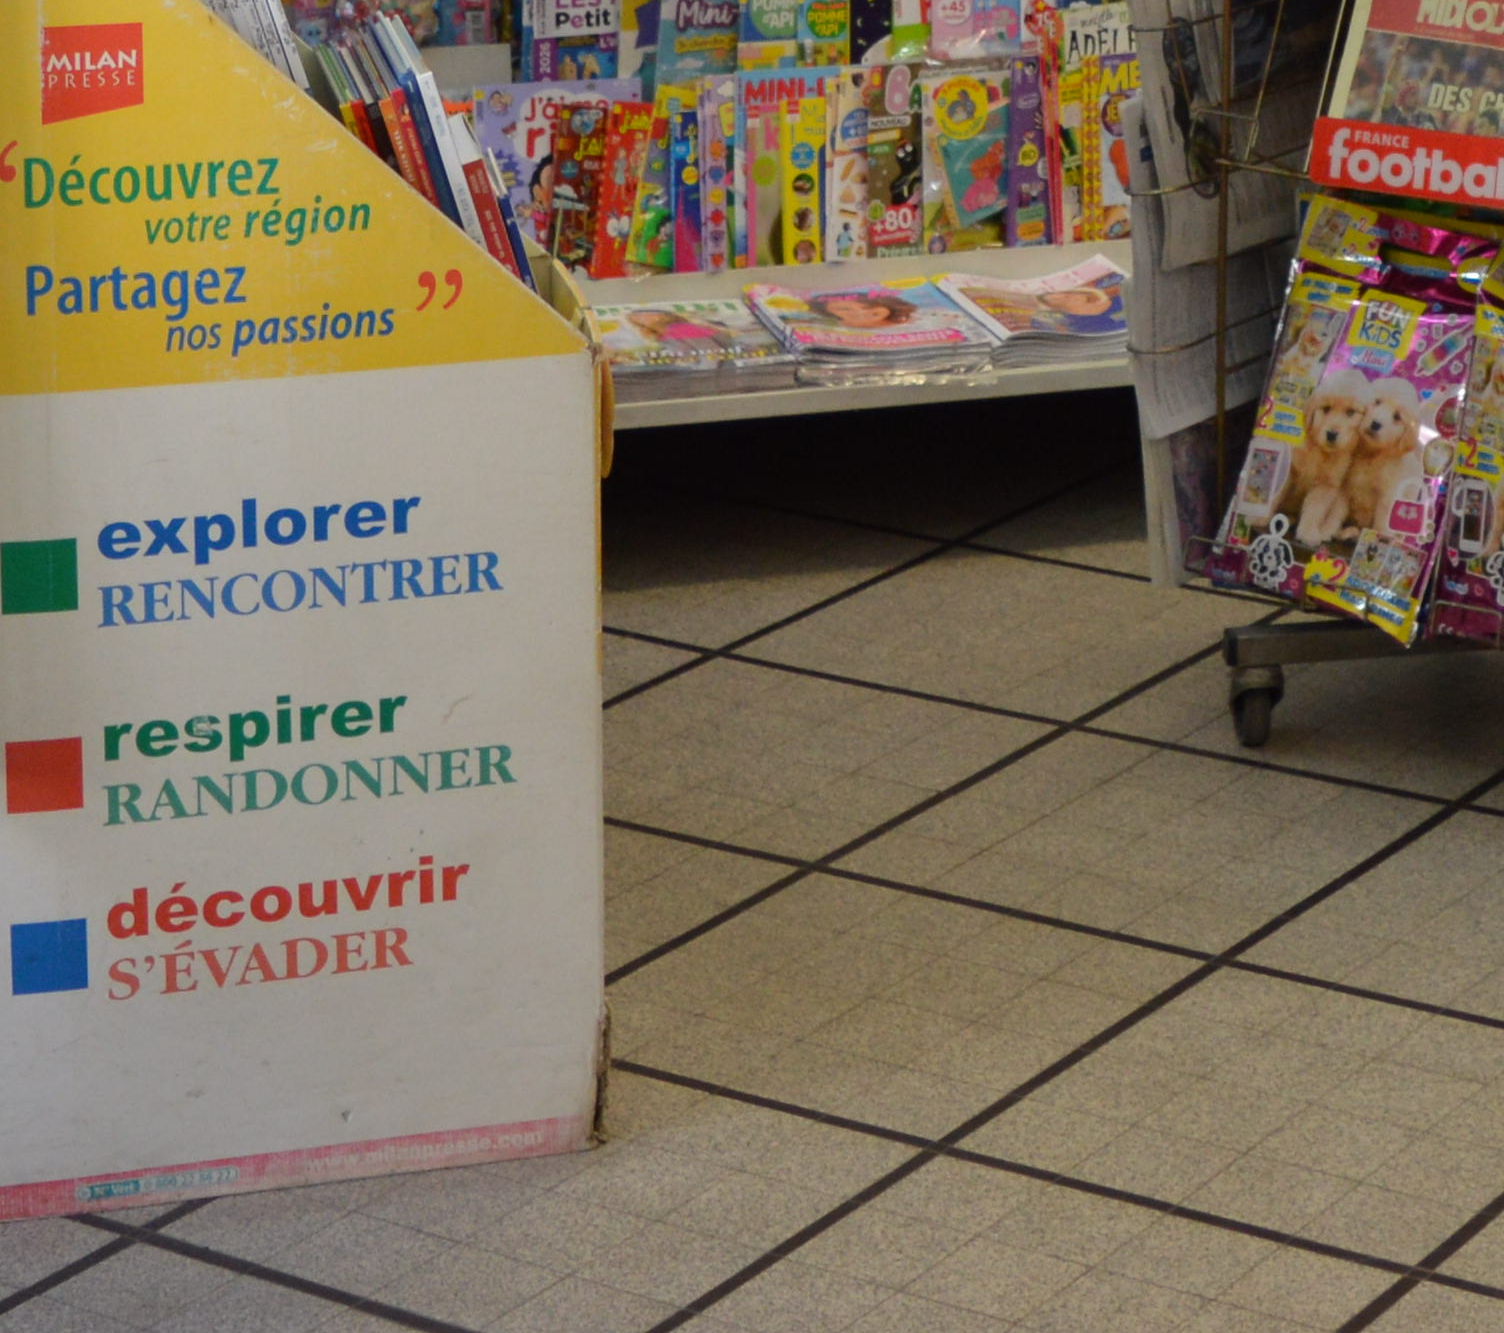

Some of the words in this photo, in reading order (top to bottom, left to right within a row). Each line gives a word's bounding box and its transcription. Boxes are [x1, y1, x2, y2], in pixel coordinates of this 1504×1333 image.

[556, 9, 610, 27] Petit
[48, 49, 137, 71] MILAN
[48, 71, 136, 88] PRESSE
[1428, 83, 1472, 114] DES
[1354, 131, 1409, 149] FRANCE
[23, 156, 279, 209] Découvrez
[144, 211, 230, 246] votre
[244, 201, 371, 247] région
[25, 266, 247, 322] Partagez
[1365, 298, 1409, 330] FUN
[165, 320, 222, 353] nos
[231, 304, 395, 358] passions
[96, 496, 421, 565] explorer
[97, 550, 504, 628] RENCONTRER
[105, 694, 408, 761] respirer
[103, 744, 517, 827] RANDONNER
[106, 855, 470, 940] découvrir
